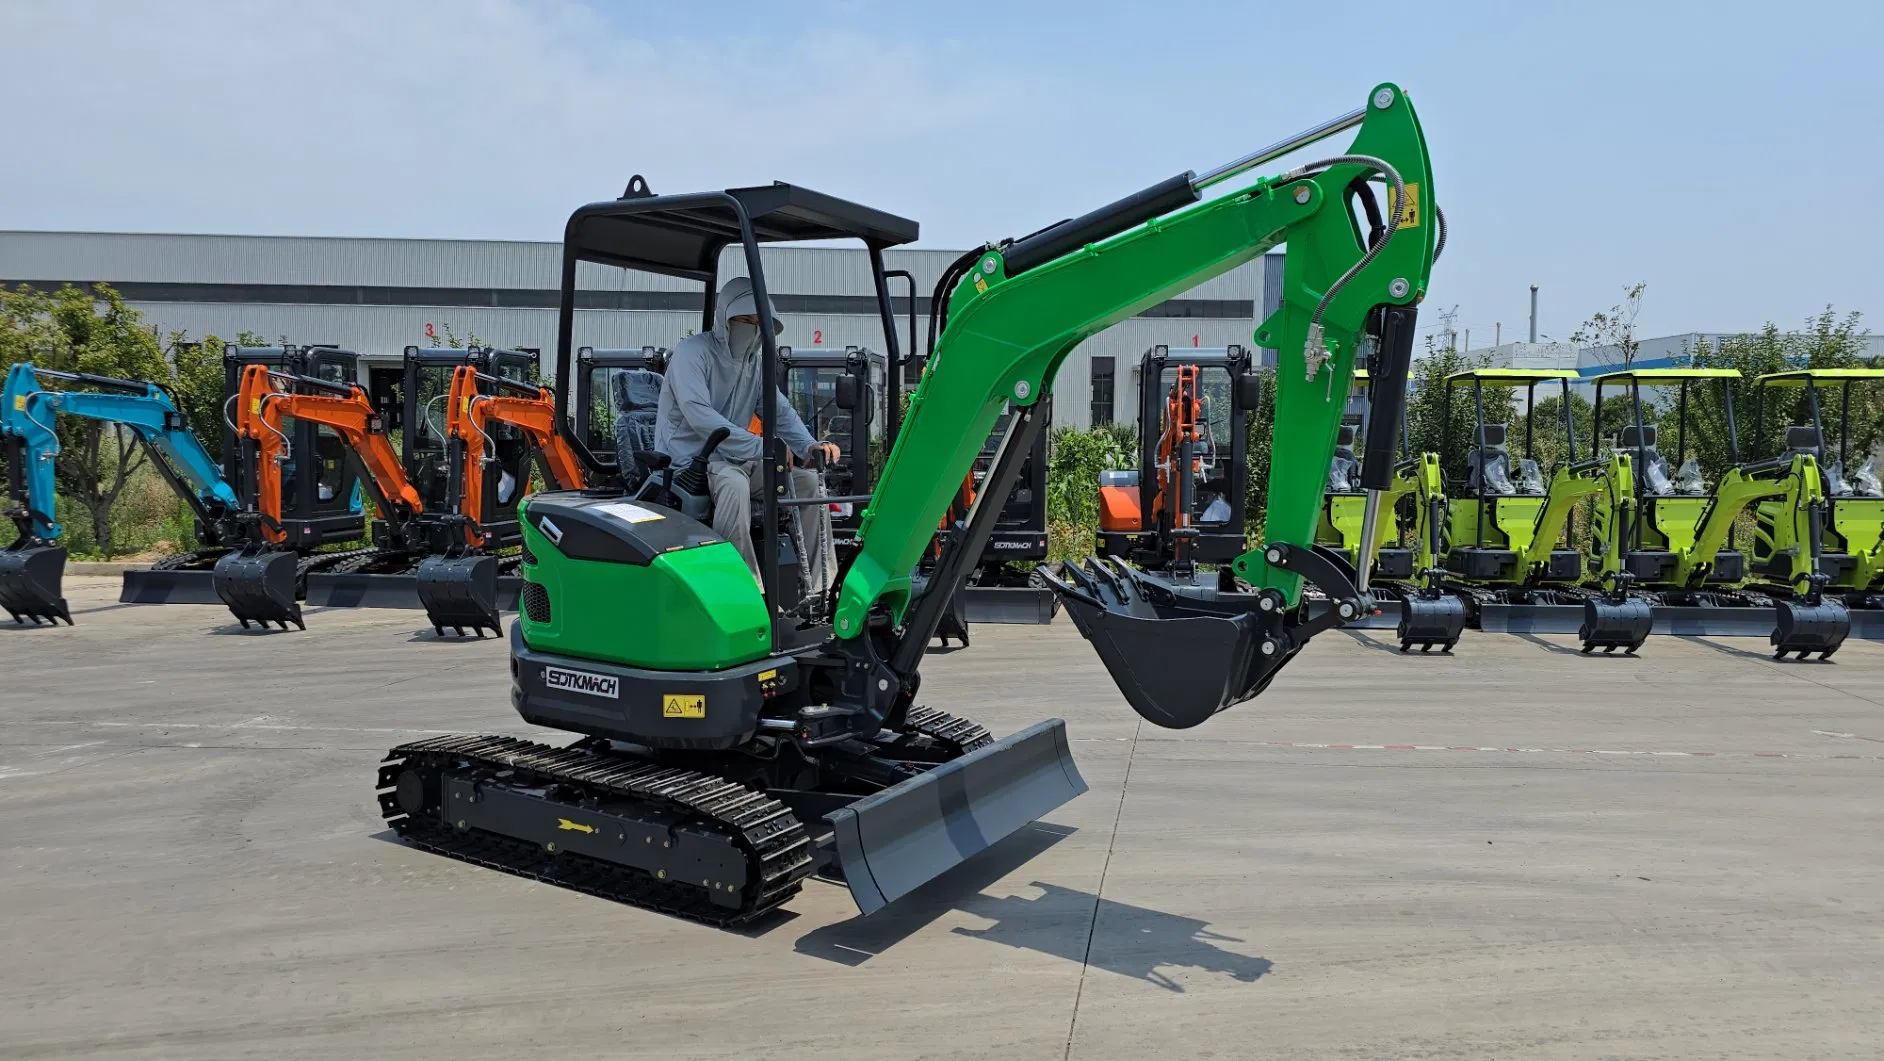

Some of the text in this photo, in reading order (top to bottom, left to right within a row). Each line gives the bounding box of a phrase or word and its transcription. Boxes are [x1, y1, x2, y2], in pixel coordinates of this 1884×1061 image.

[425, 323, 433, 337] 3
[814, 330, 822, 344] 2
[1192, 335, 1199, 348] 1
[548, 670, 616, 695] SDTKMACH
